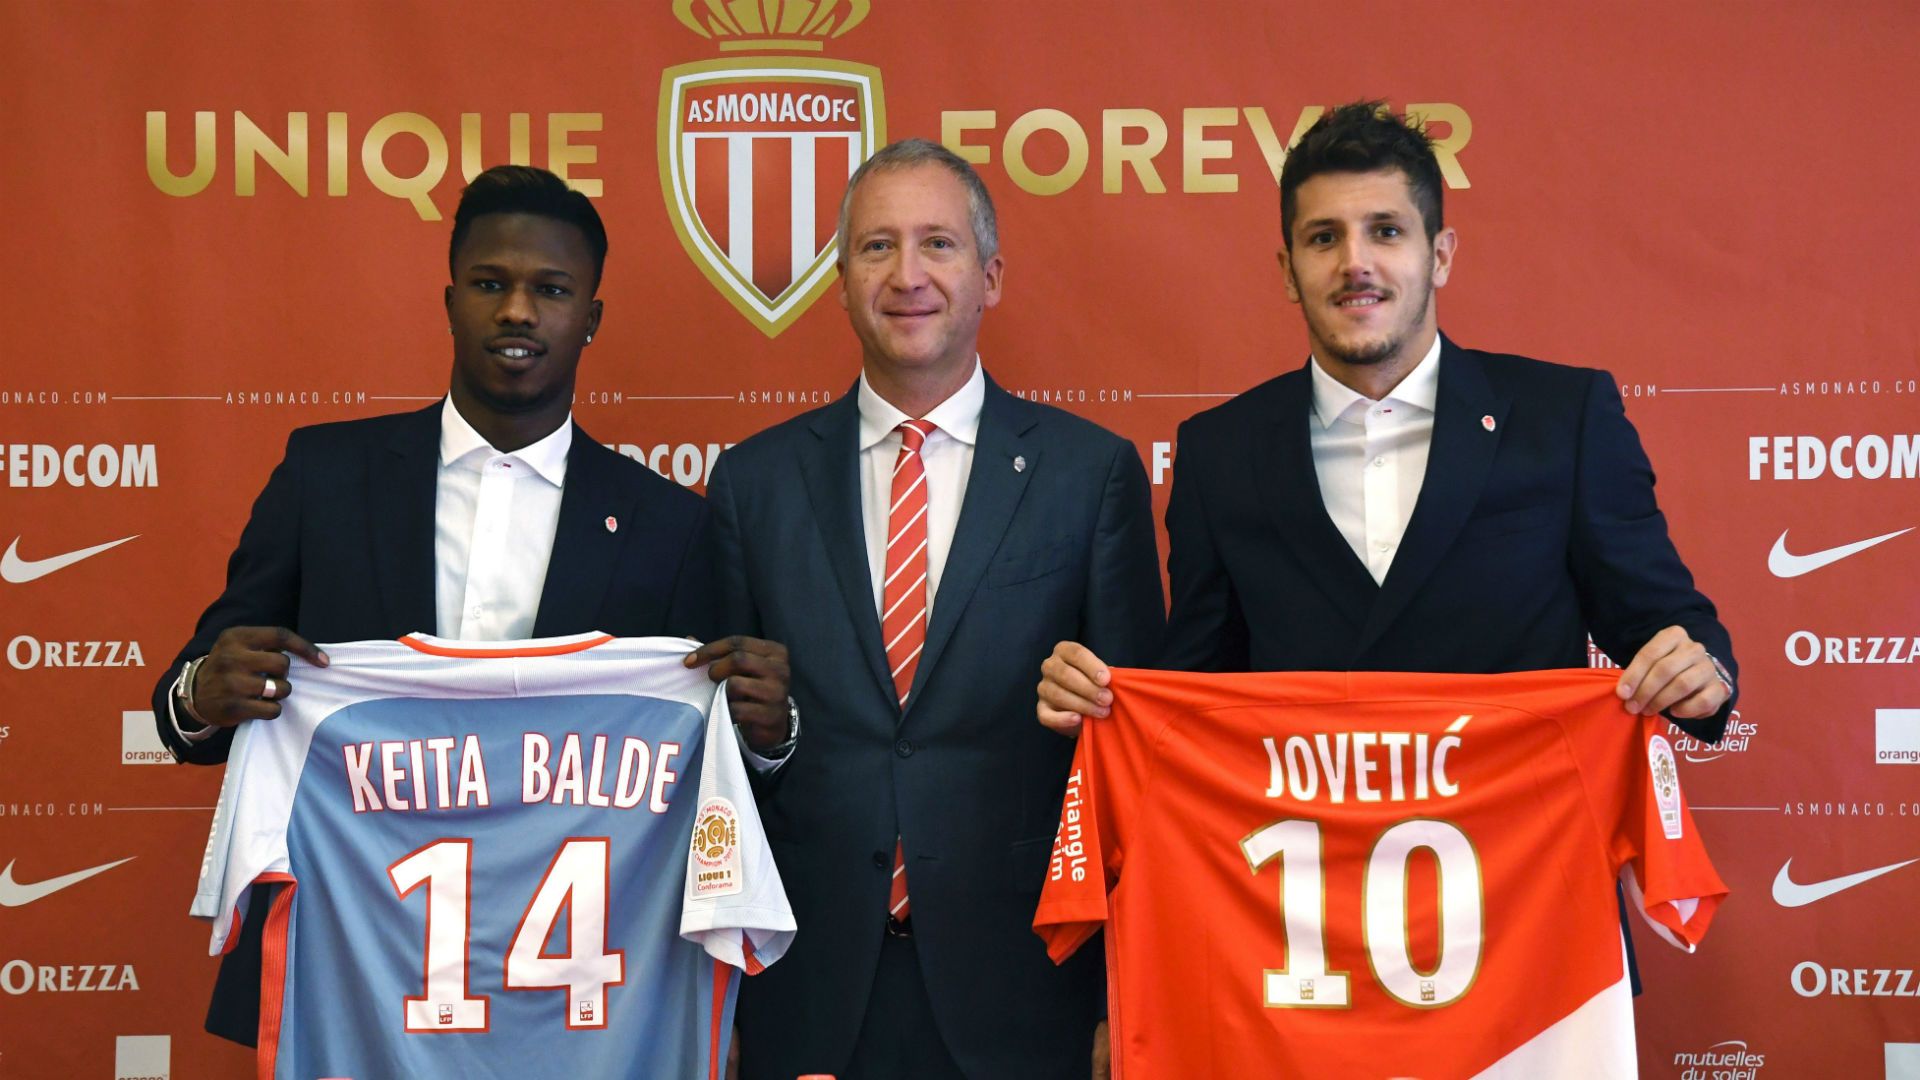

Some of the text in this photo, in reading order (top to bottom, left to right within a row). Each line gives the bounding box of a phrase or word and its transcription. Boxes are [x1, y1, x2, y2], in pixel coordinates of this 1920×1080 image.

[146, 102, 1472, 221] UNIQUE FOREVR
[226, 391, 366, 405] ASMONACO.COM
[738, 391, 832, 404] ASMONACO
[1007, 389, 1132, 402] MONACO.COM
[0, 443, 159, 487] EDCOM
[1749, 434, 1920, 480] FEDCOM
[6, 635, 145, 670] OREZZA
[124, 750, 170, 763] orange
[1262, 714, 1474, 803] JOVETIĆ
[1674, 736, 1700, 752] du
[1878, 749, 1920, 762] orang
[342, 732, 681, 814] KEITA BALDE
[1065, 768, 1087, 882] Triangle
[698, 871, 724, 882] LIGUE
[698, 881, 733, 891] Conforama
[1238, 816, 1485, 1010] 10
[386, 836, 625, 1034] 14
[0, 959, 140, 995] OREZZA
[1790, 961, 1920, 997] OREZZ
[1673, 1050, 1765, 1067] mutuelles
